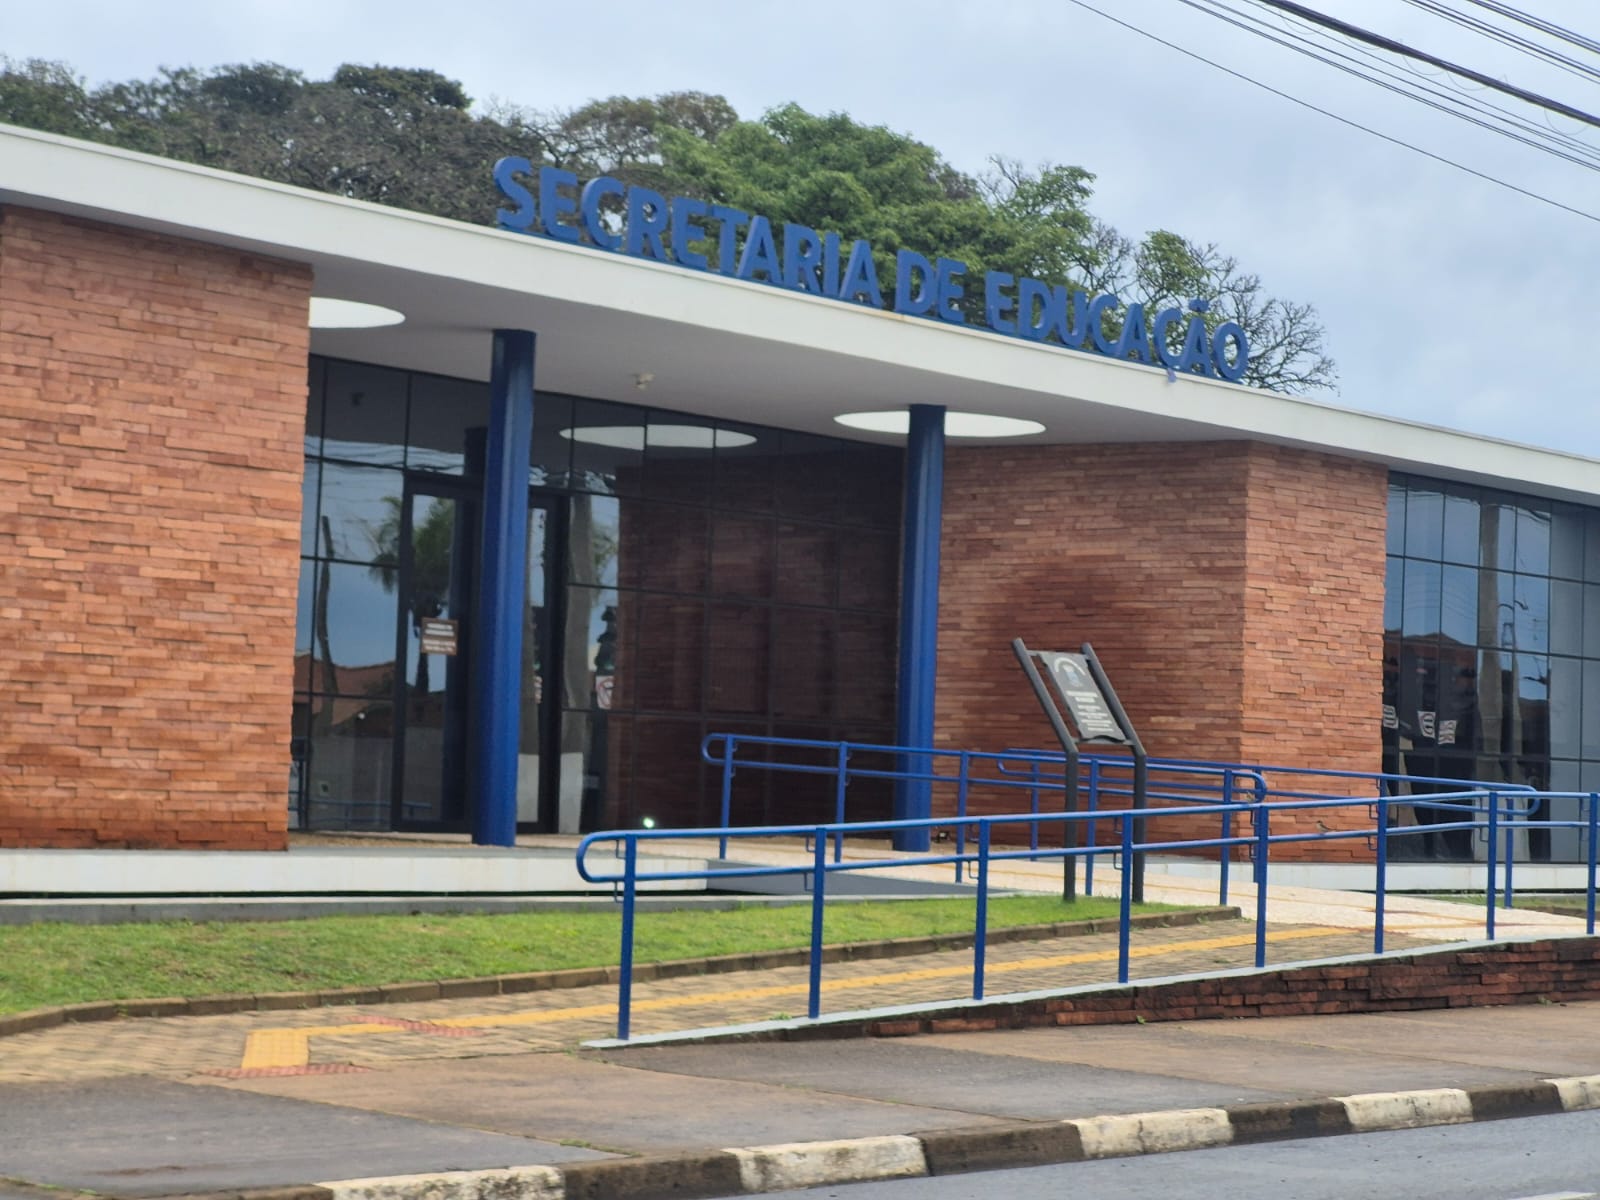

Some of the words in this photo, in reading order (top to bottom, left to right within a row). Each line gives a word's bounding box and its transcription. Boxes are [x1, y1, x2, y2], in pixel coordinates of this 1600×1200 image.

[493, 156, 882, 308] SECRETARIA
[894, 249, 966, 323] DE
[985, 270, 1250, 383] EDUCAÇÃO
